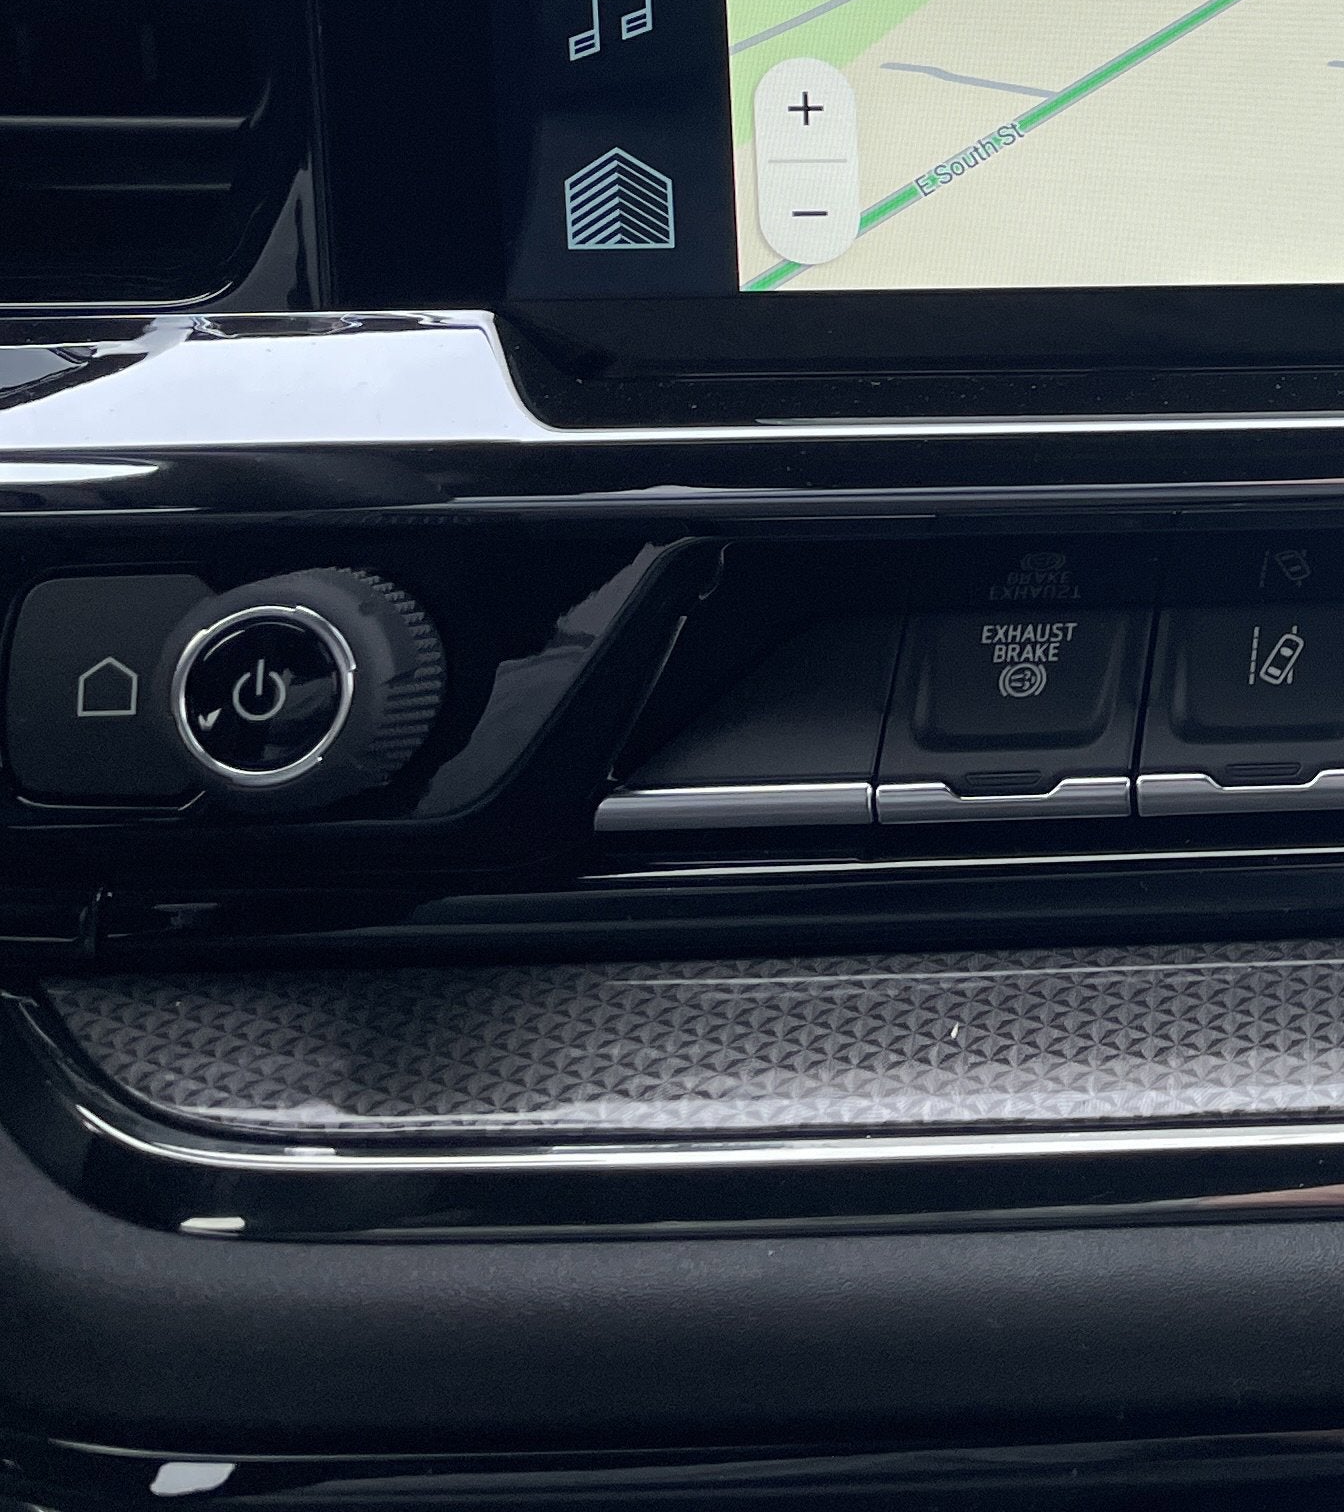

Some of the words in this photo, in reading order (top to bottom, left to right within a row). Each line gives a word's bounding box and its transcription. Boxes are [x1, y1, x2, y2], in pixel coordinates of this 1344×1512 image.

[915, 172, 934, 198] E
[933, 138, 999, 186] South
[995, 122, 1025, 147] St
[981, 622, 1077, 647] EXHAUST
[993, 641, 1060, 665] BRAKE
